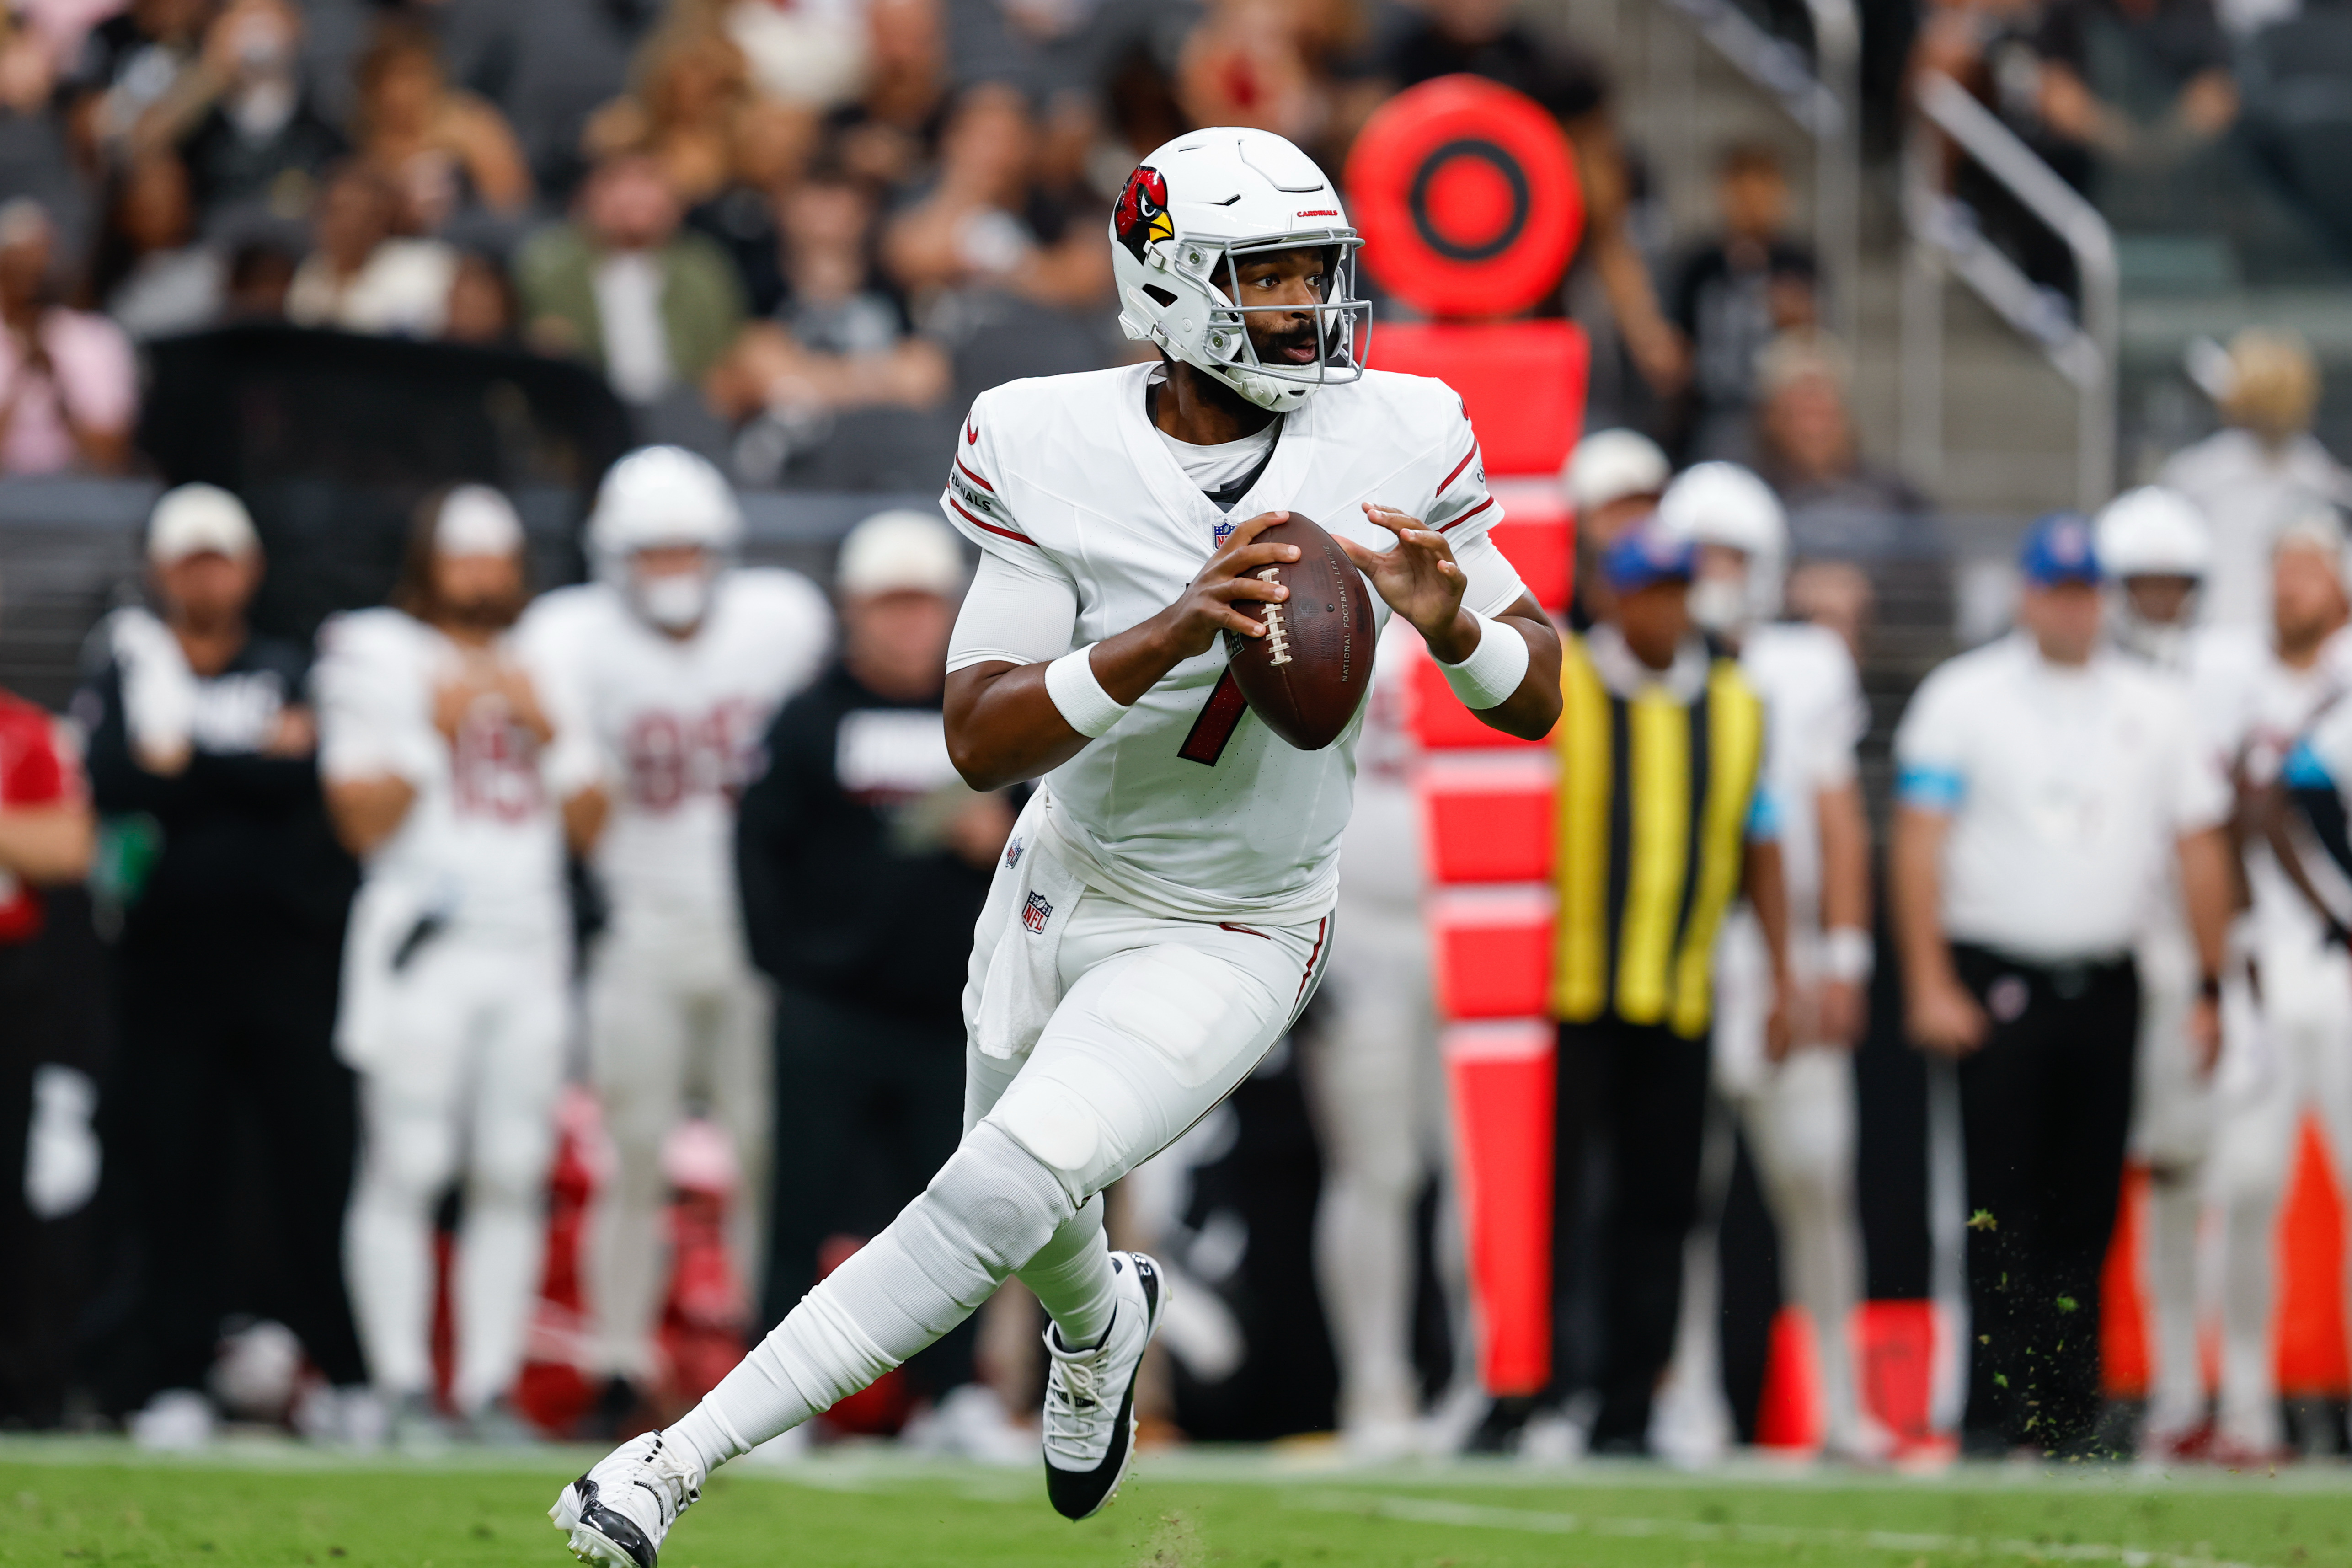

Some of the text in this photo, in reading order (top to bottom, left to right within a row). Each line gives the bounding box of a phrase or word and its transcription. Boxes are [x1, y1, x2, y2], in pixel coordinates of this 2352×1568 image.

[1322, 545, 1351, 682] NATIONAL FOOTBALL LEAGUE
[1023, 904, 1044, 931] NFL
